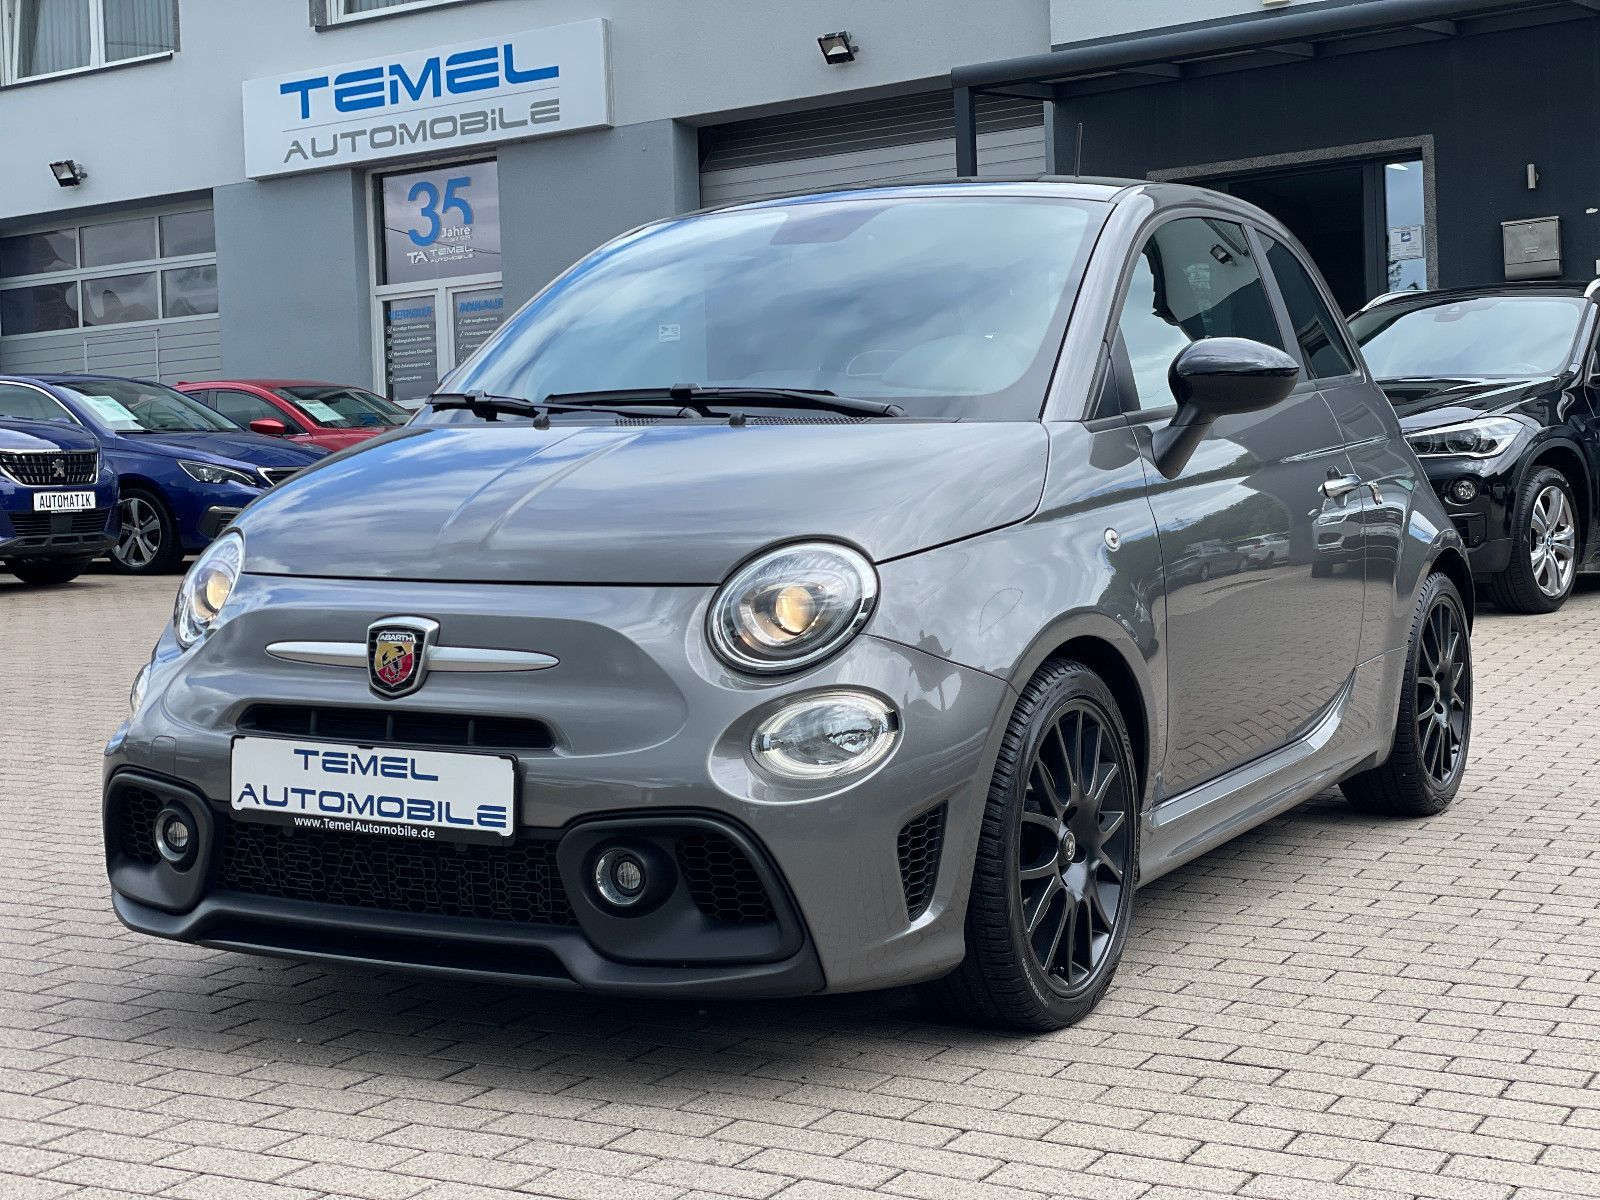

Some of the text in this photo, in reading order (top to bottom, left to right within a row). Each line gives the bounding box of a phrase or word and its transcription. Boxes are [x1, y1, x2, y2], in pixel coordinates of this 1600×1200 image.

[280, 43, 560, 120] TEMEL
[407, 176, 474, 247] 35
[441, 225, 471, 238] Jahre
[430, 245, 474, 256] TEMEL
[40, 494, 91, 508] AUTOMATIK
[293, 748, 439, 782] TEMEL
[237, 783, 507, 828] AUTOMOBILE
[294, 816, 436, 839] www.TemelAutomobile.de
[227, 838, 553, 914] ABARTH
